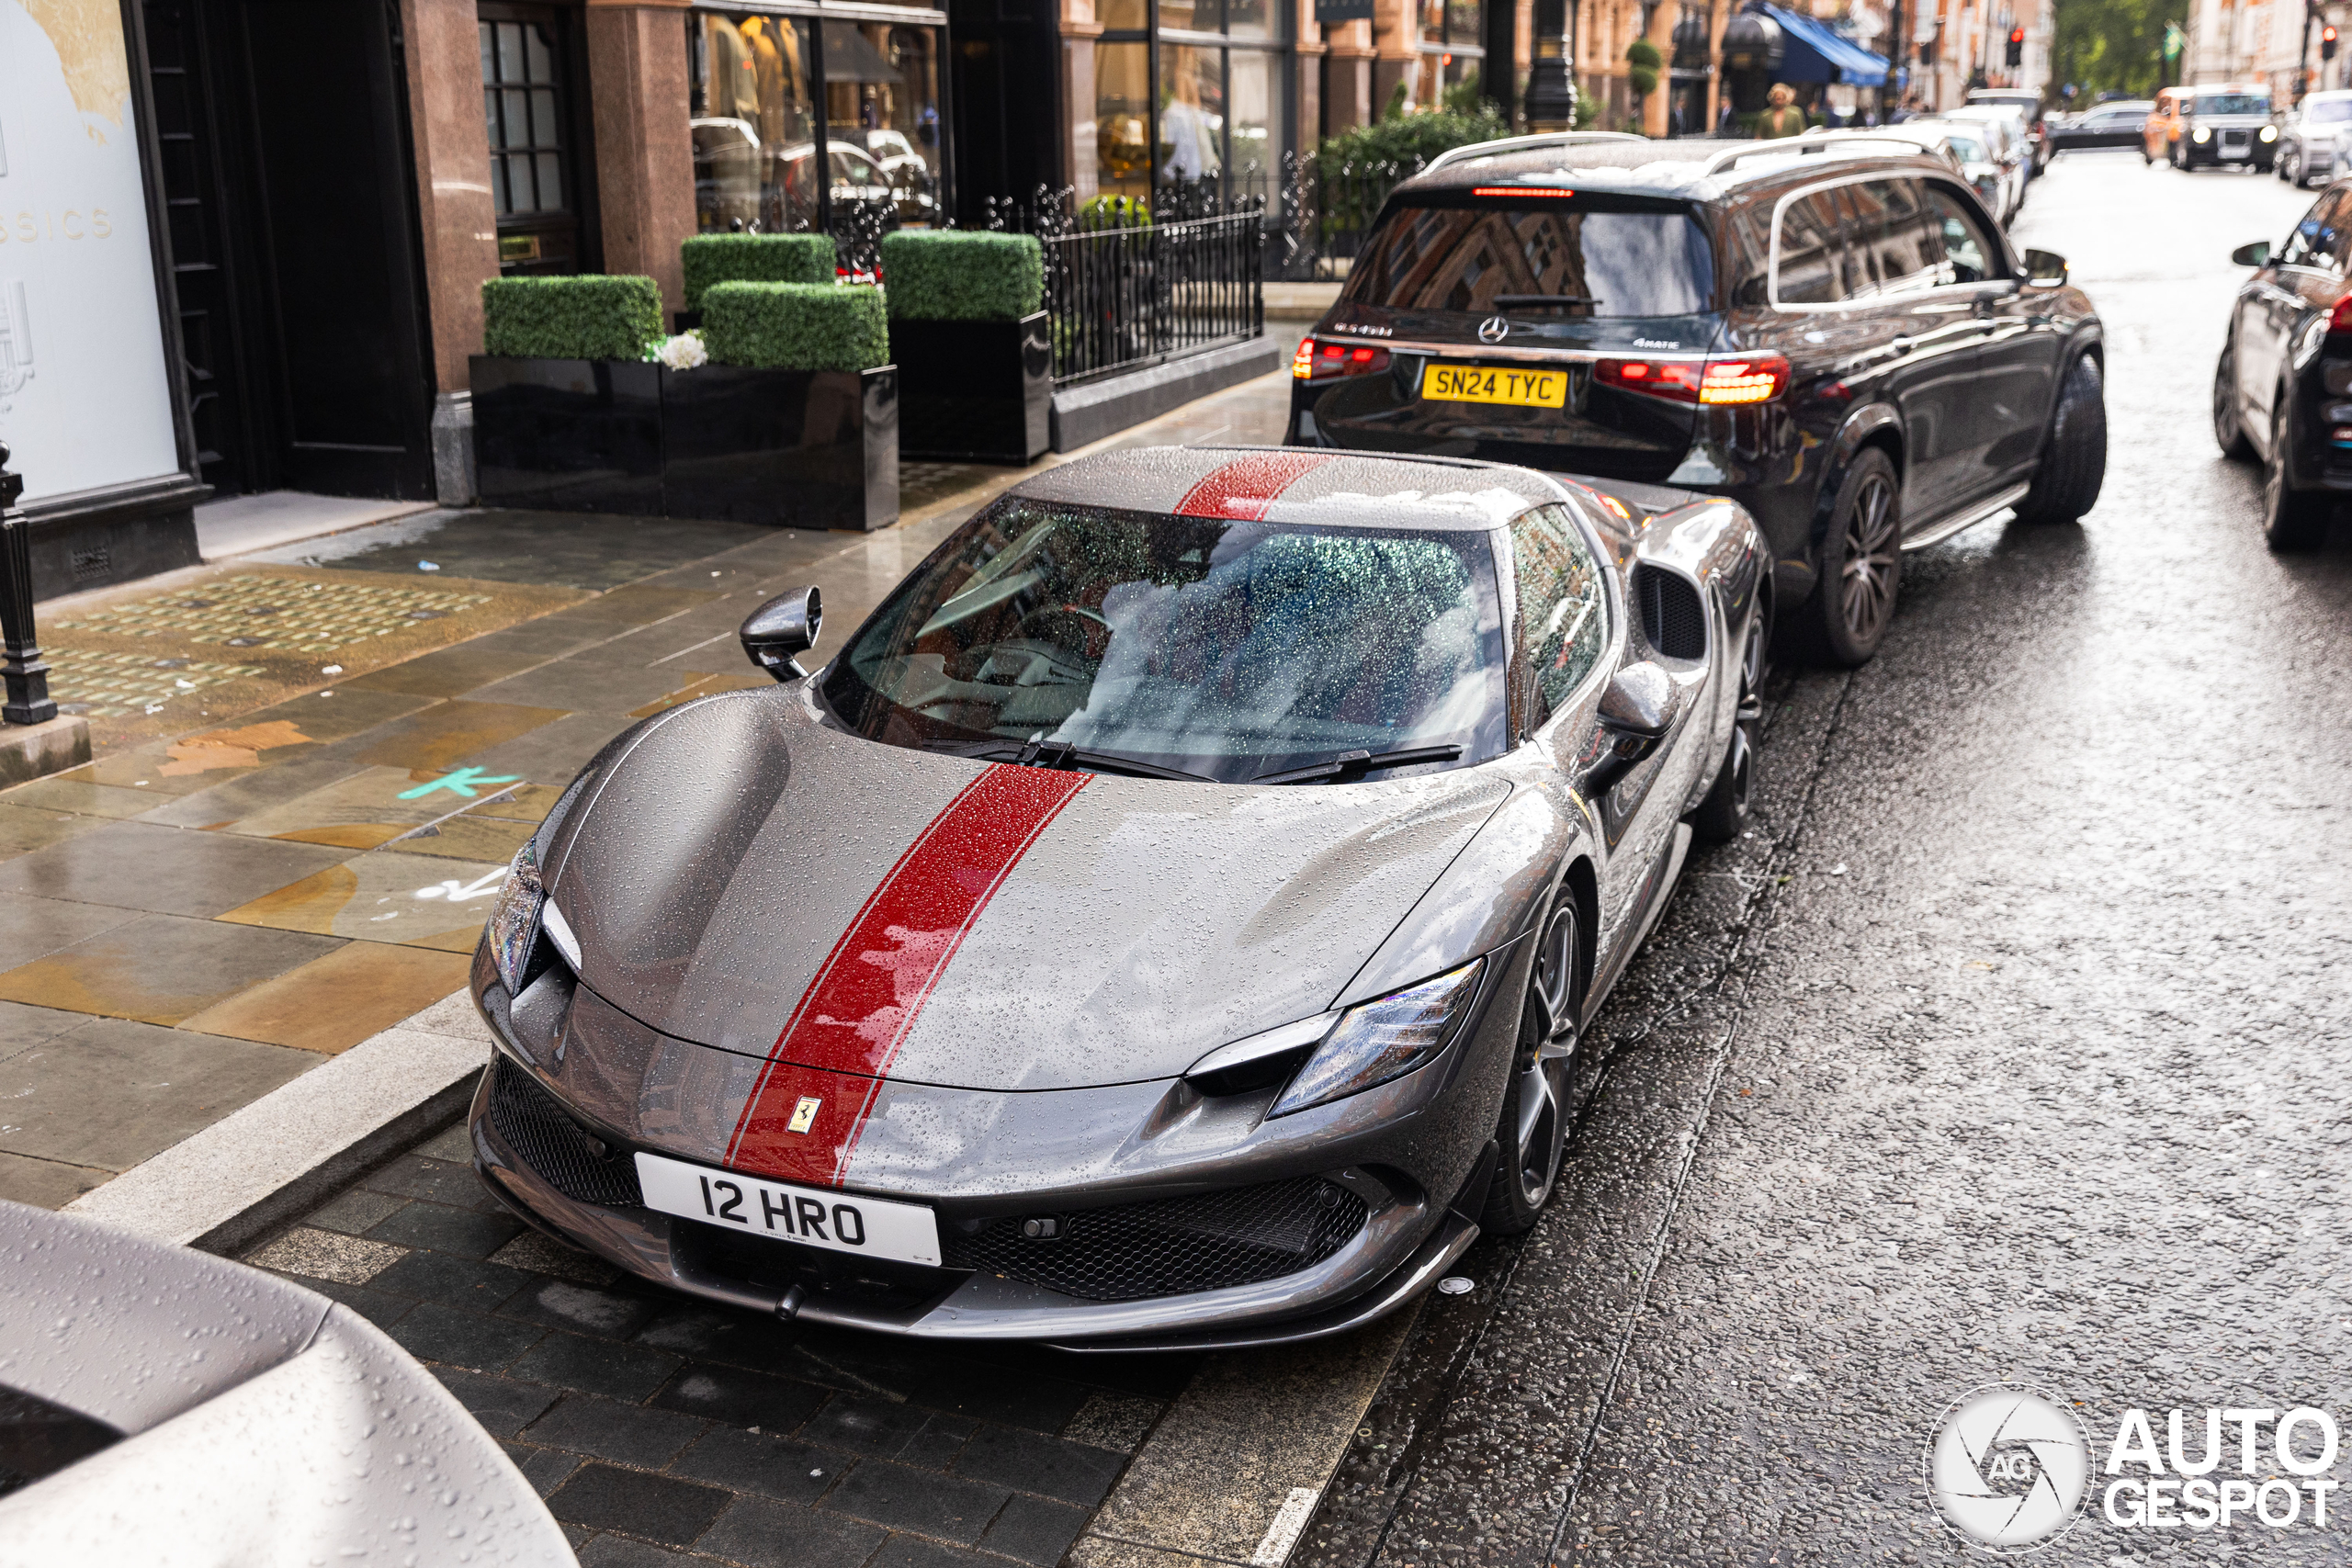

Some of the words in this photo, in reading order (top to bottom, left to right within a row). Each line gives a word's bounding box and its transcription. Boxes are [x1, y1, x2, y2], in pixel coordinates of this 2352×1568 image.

[1436, 371, 1496, 397] SN24
[1508, 374, 1553, 400] TYC
[699, 1175, 748, 1224] 12
[759, 1188, 866, 1246] HRO
